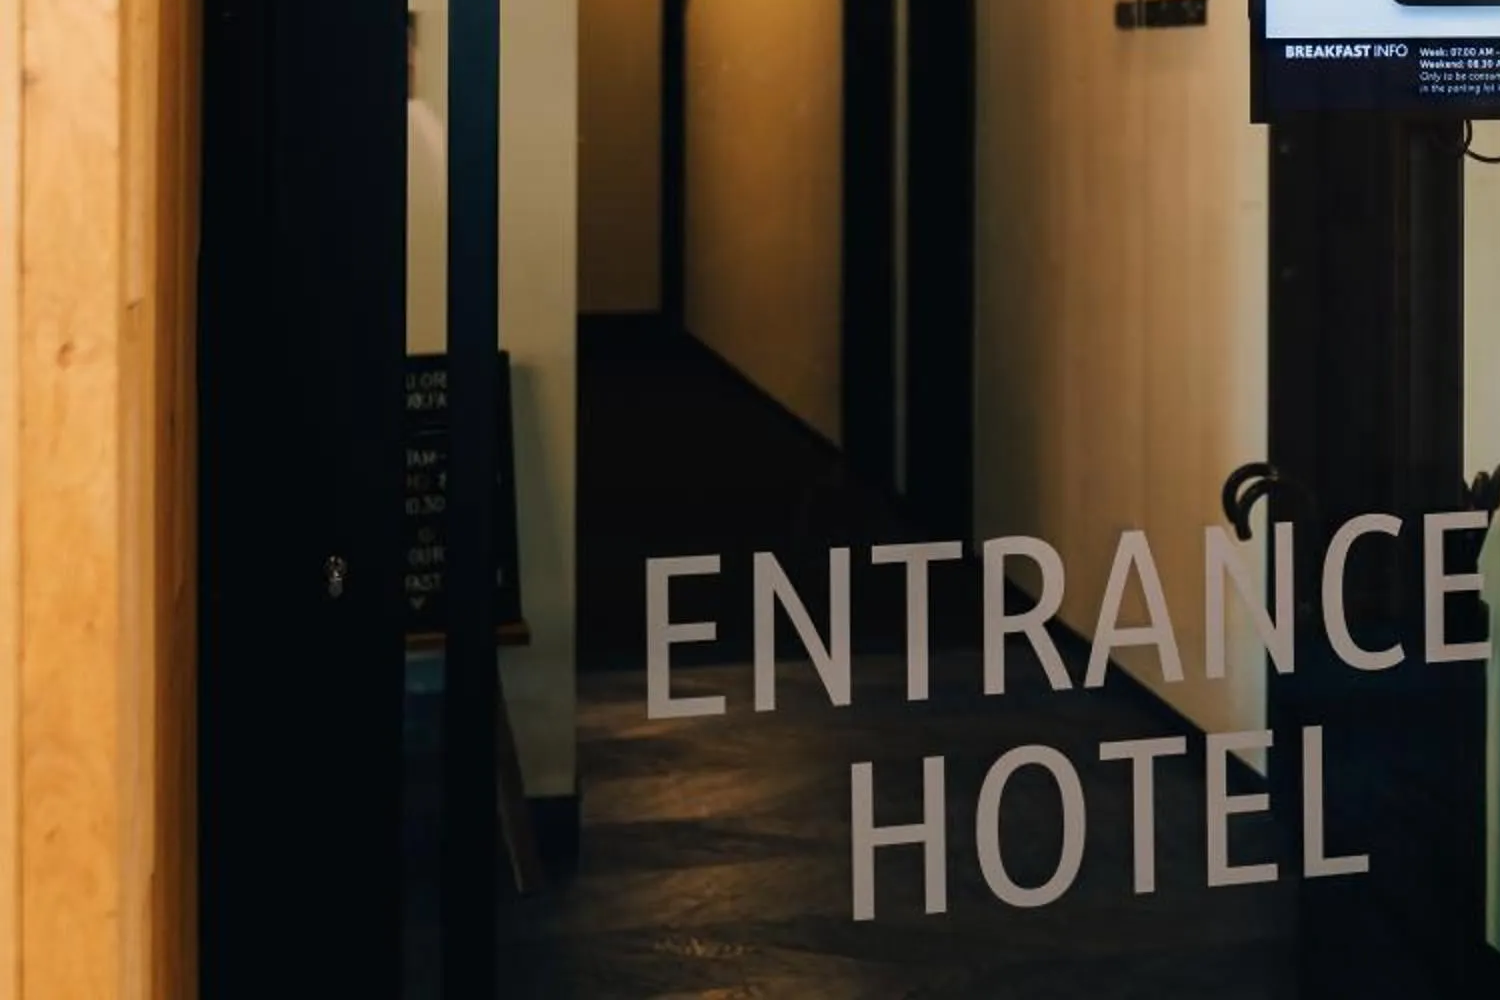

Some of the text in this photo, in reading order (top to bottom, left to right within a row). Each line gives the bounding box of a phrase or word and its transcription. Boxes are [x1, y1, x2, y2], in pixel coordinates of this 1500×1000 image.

[1285, 43, 1408, 58] BREAKFAST INFO
[1479, 47, 1494, 56] AM
[645, 510, 1491, 720] ENTRANCE
[850, 725, 1370, 921] HOTEL
